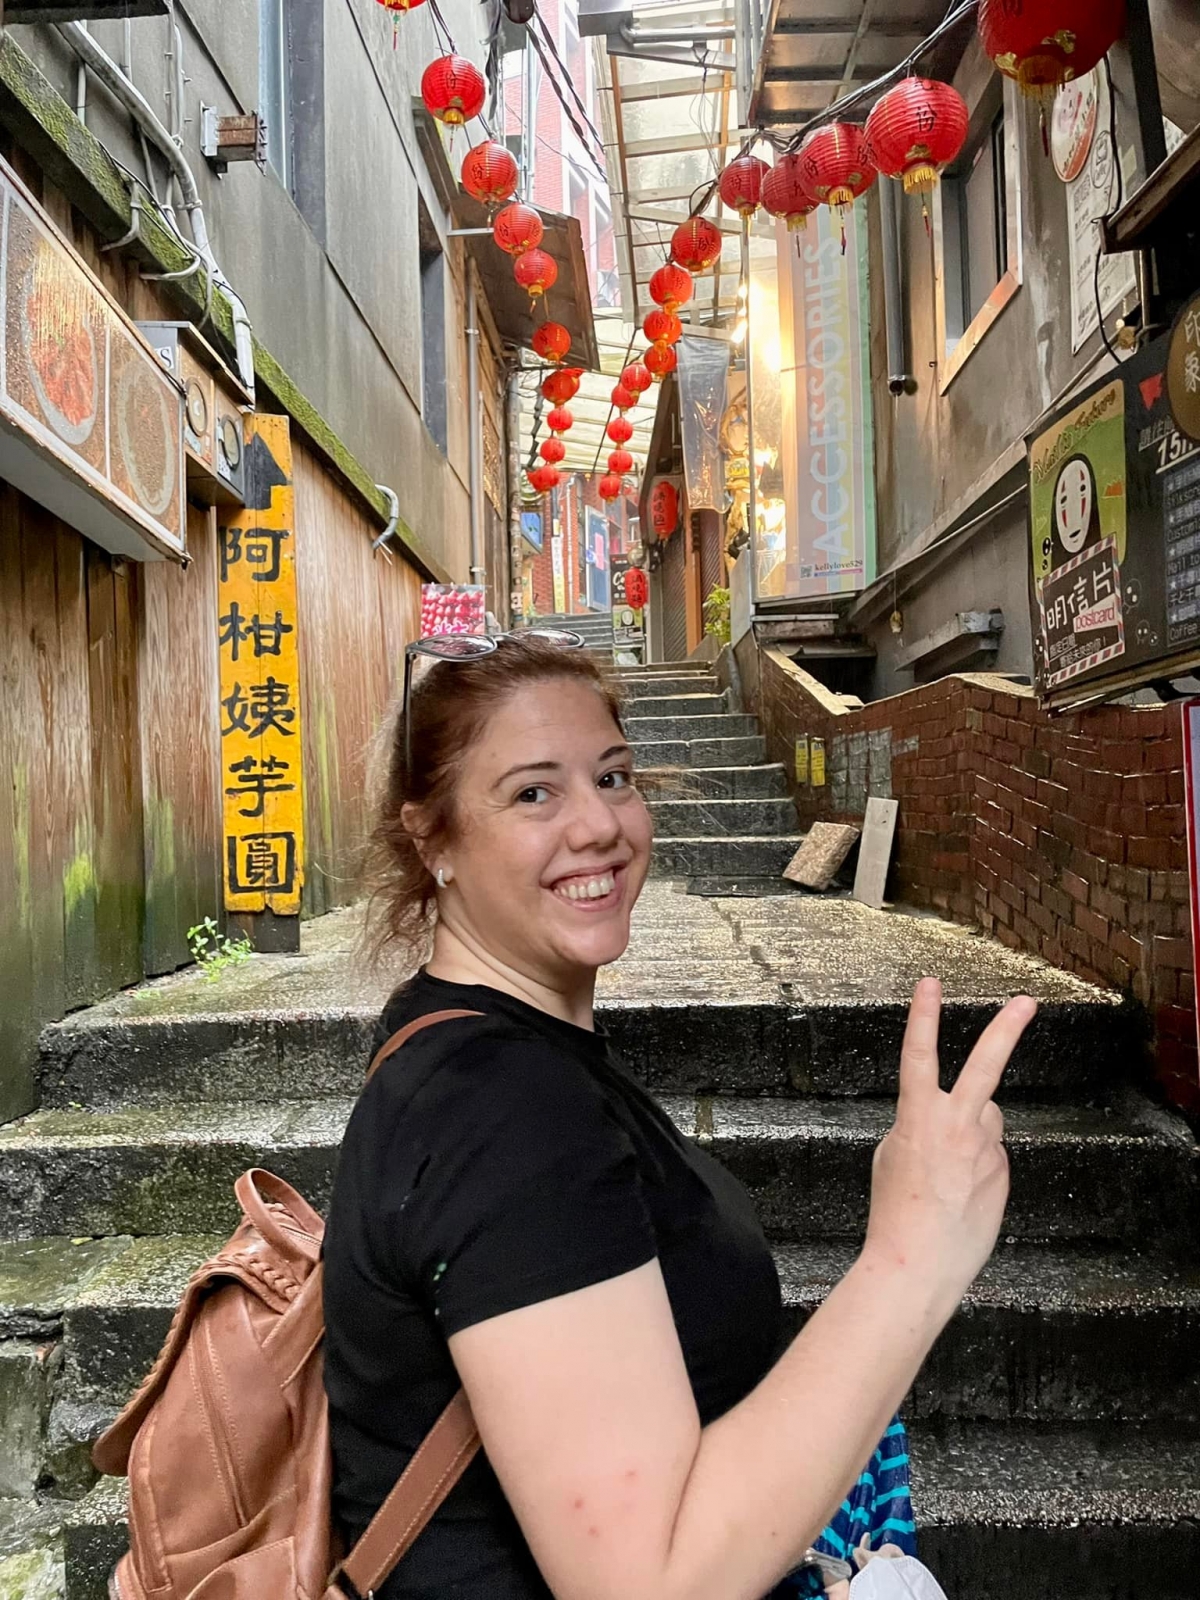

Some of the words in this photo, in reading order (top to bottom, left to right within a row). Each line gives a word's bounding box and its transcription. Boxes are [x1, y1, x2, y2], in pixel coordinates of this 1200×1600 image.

[805, 236, 849, 557] ACCESSORIES
[1046, 561, 1112, 630] 明信片
[1075, 605, 1115, 632] postcard
[219, 527, 297, 894] 阿柑姨芋圓
